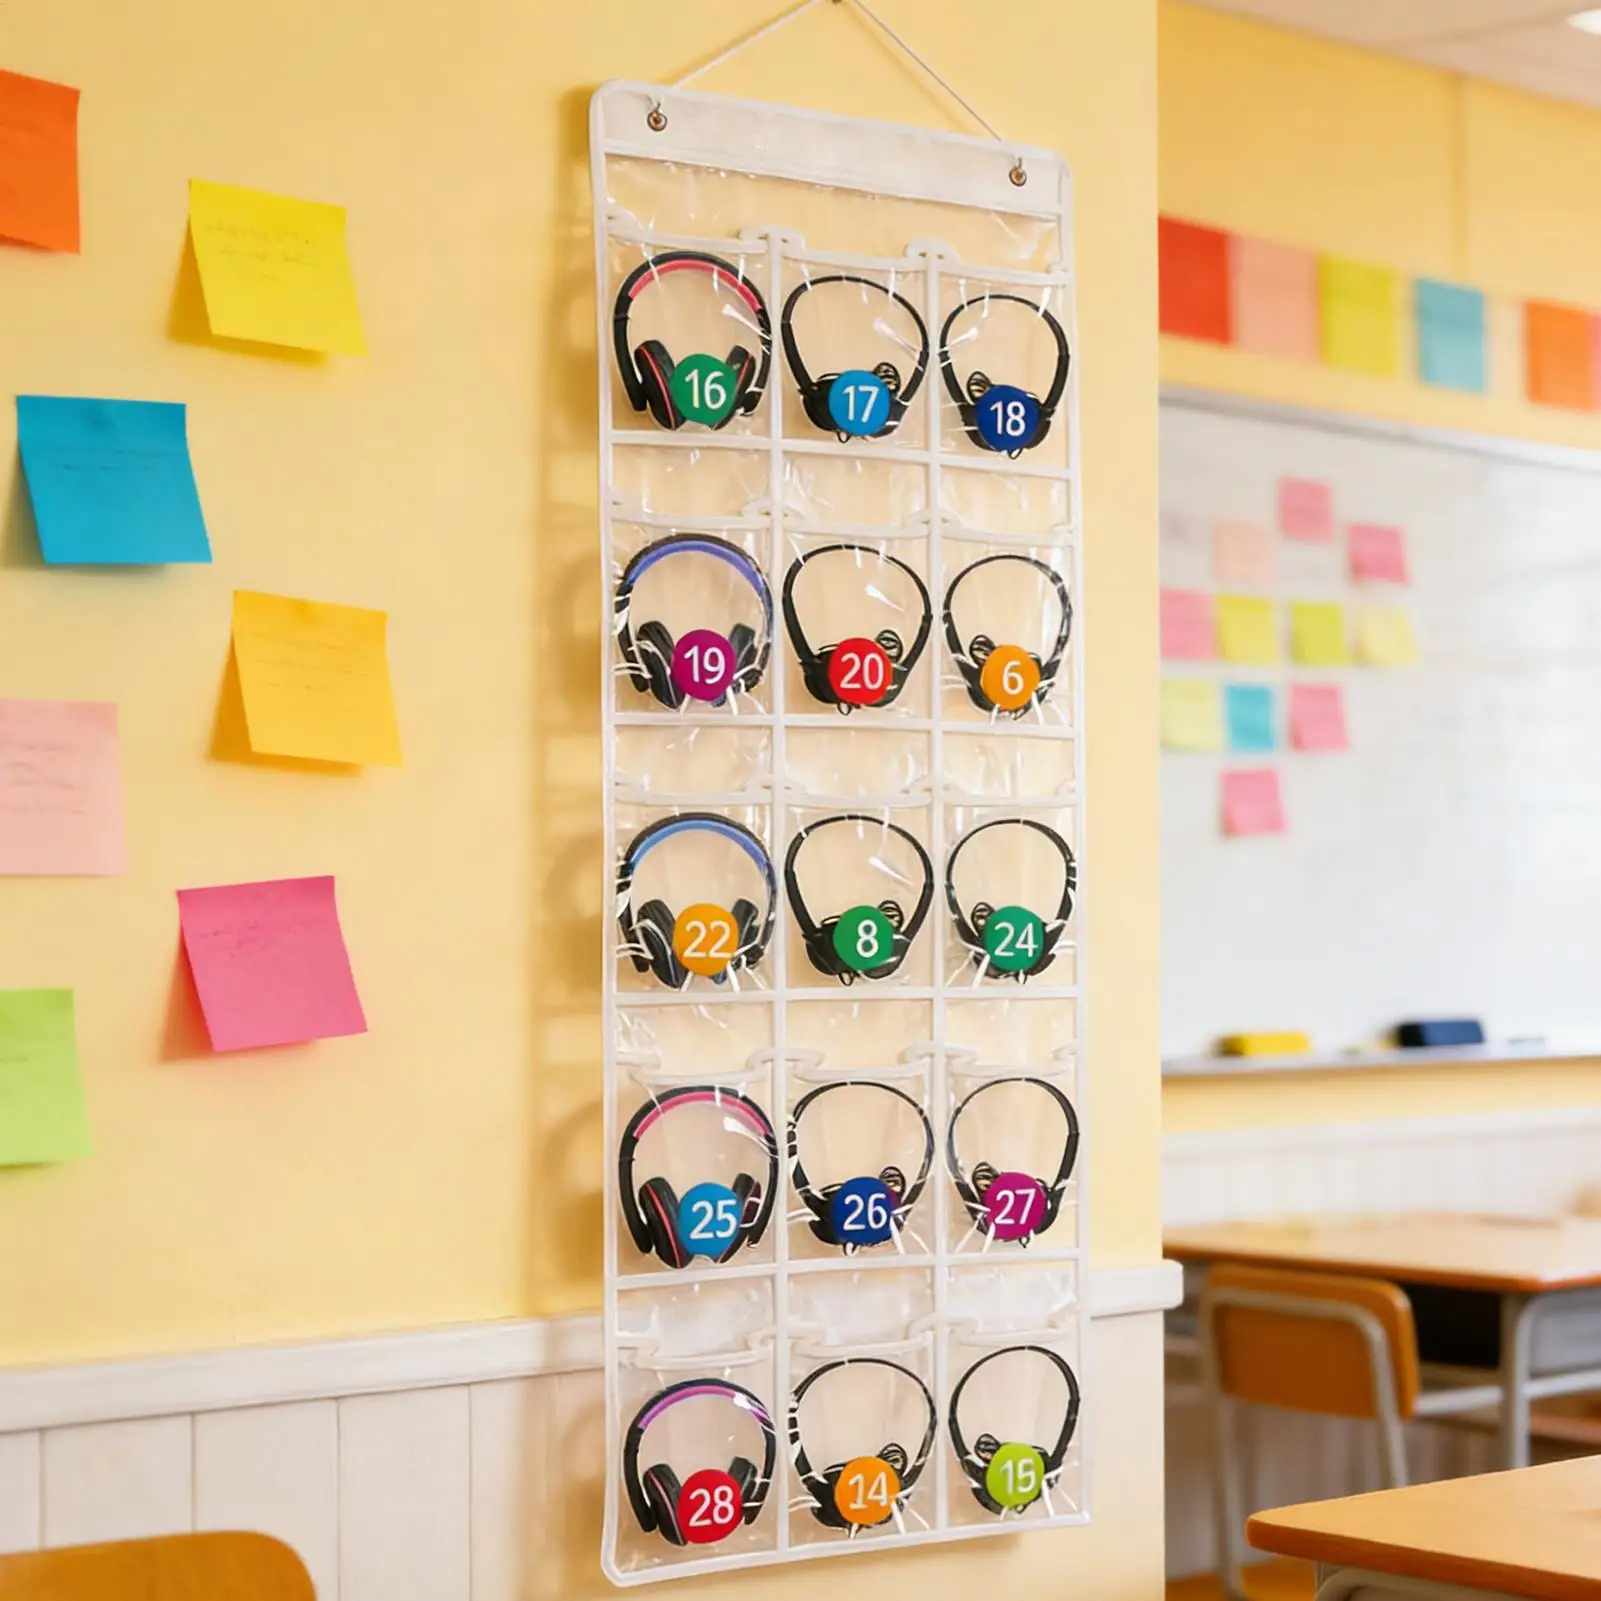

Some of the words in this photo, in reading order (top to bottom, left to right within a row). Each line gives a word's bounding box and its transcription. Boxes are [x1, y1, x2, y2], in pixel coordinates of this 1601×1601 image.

[686, 369, 726, 409] 16
[845, 386, 878, 422] 17
[991, 402, 1025, 436] 18
[685, 646, 724, 683] 19
[841, 653, 883, 689] 20
[1003, 661, 1023, 694] 6
[685, 921, 729, 957] 22
[857, 920, 878, 957] 8
[995, 922, 1037, 956] 24
[691, 1200, 736, 1239] 25
[844, 1193, 887, 1230] 26
[995, 1189, 1035, 1224] 27
[850, 1472, 887, 1508] 14
[1003, 1459, 1035, 1492] 15
[690, 1486, 733, 1526] 28
